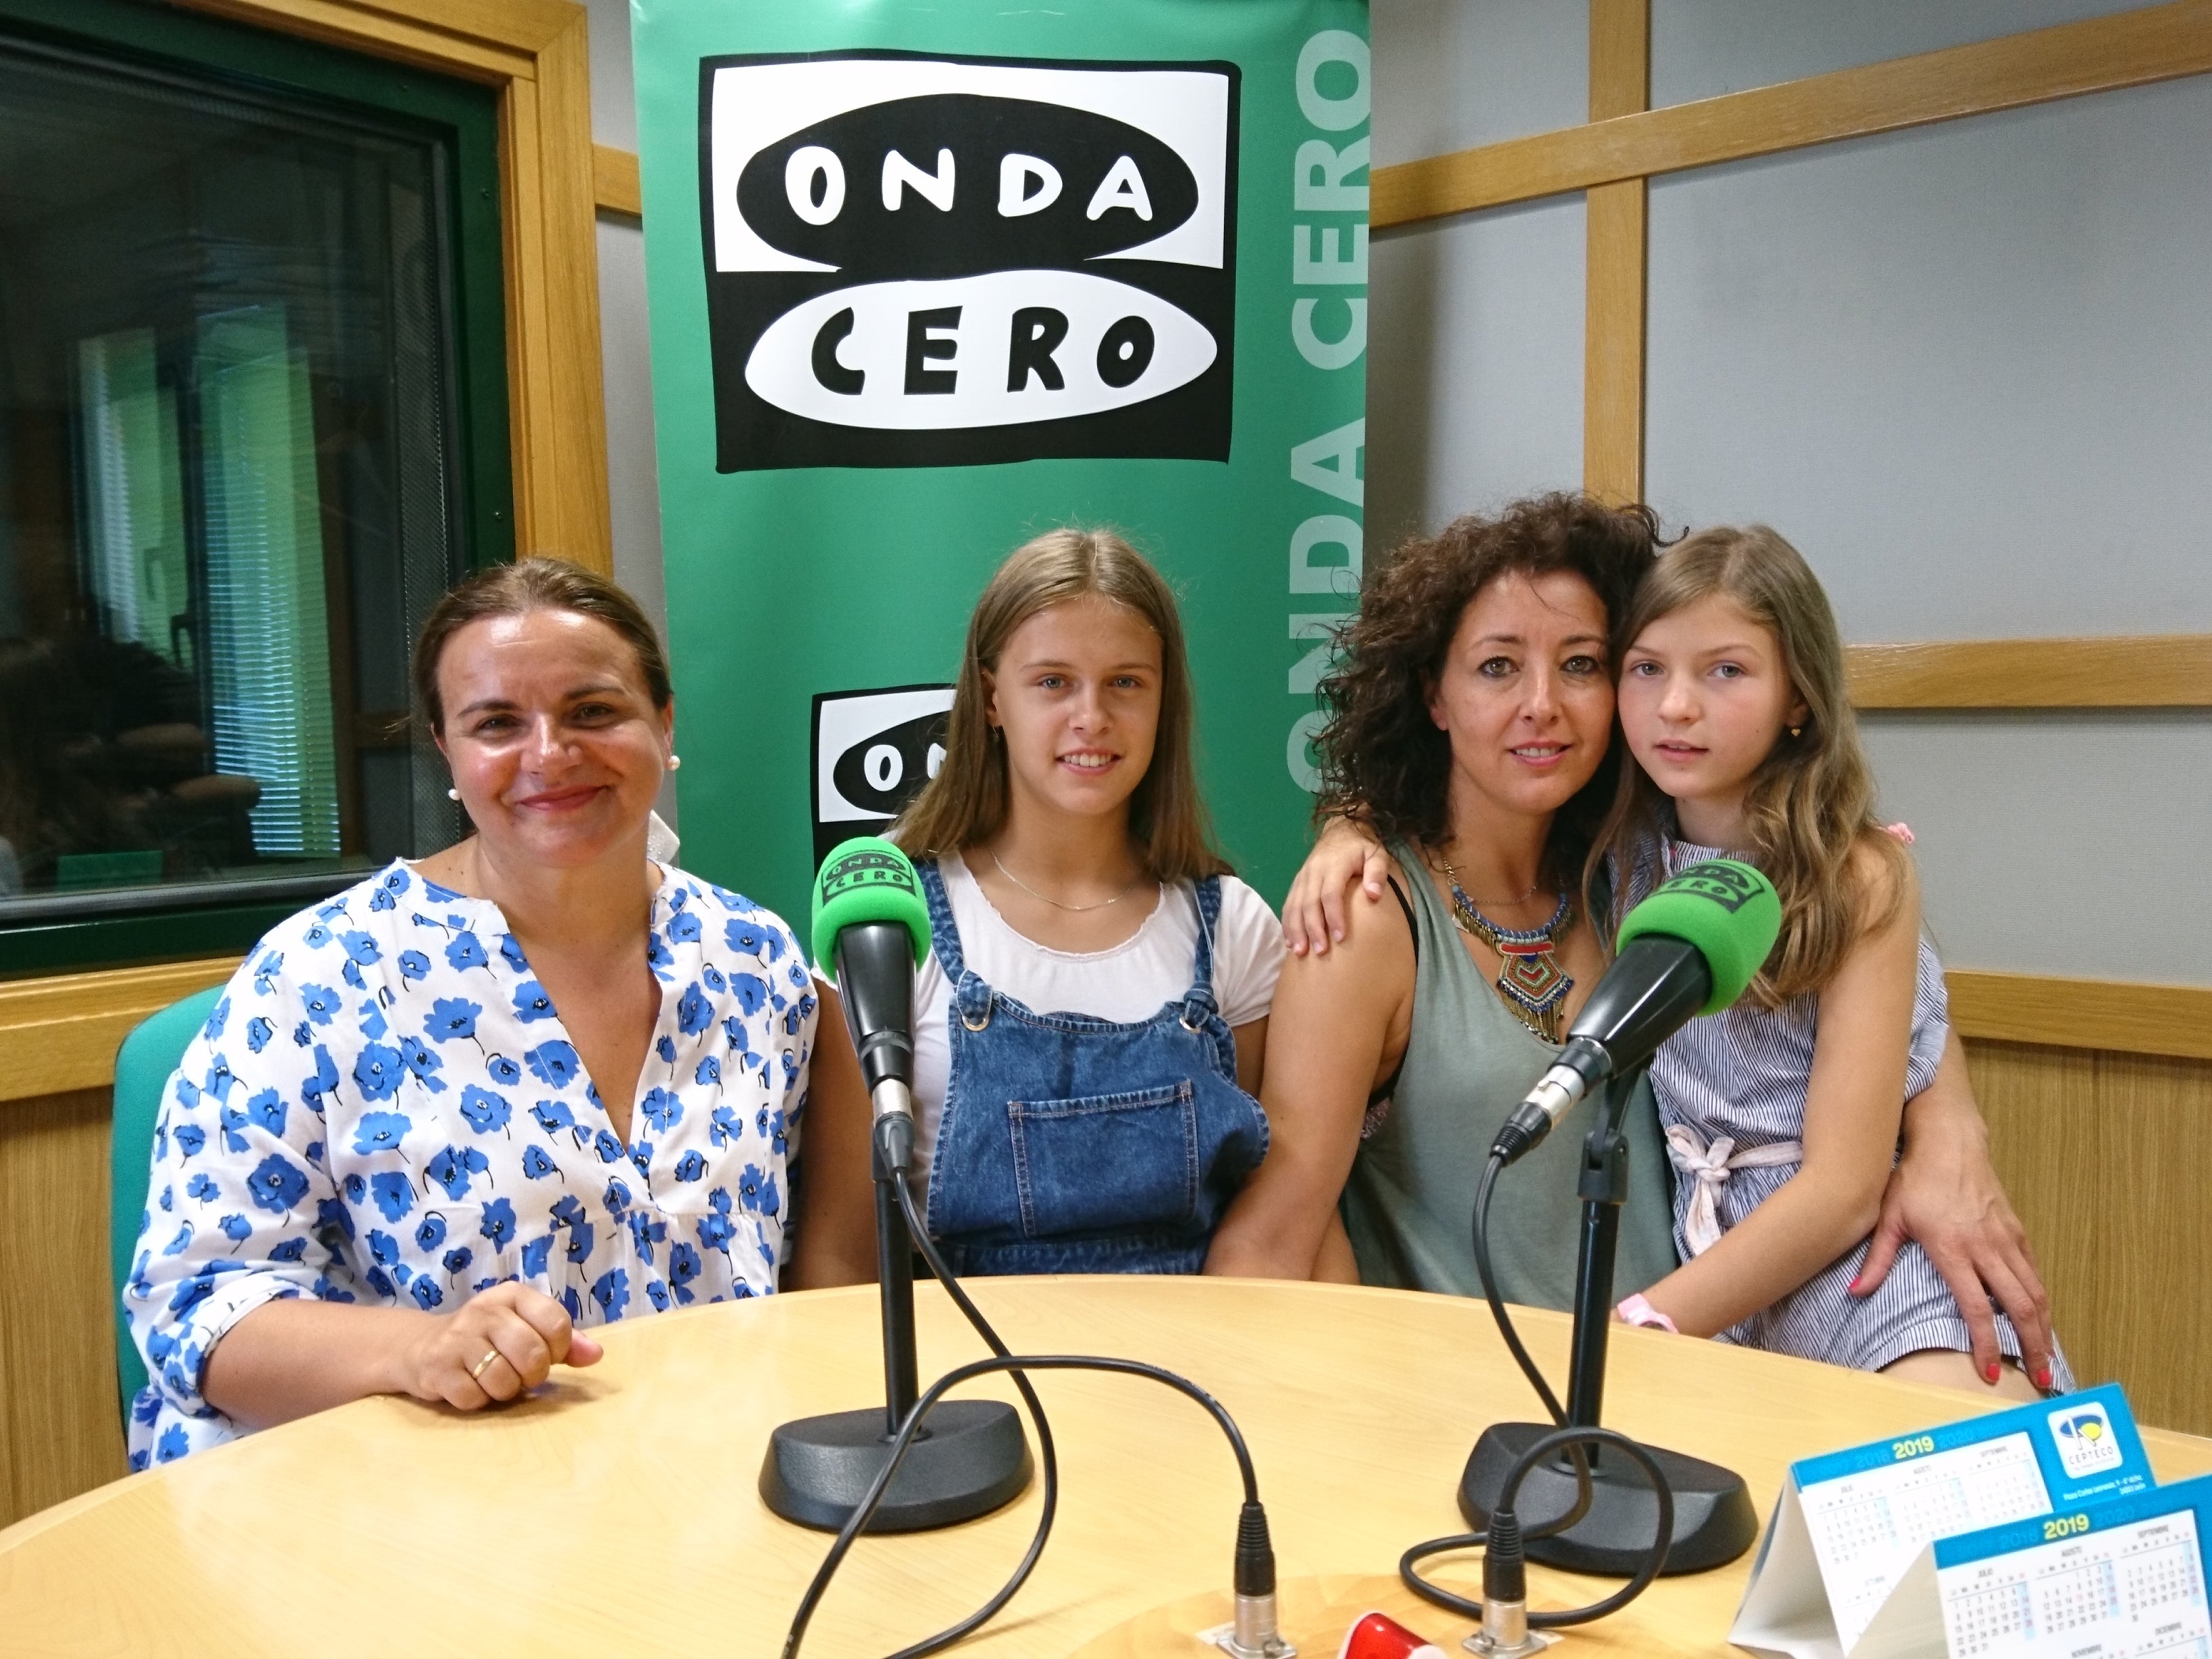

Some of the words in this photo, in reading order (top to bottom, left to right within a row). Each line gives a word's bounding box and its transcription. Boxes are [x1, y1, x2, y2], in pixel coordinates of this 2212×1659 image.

[784, 145, 1153, 226] ONDA
[1292, 29, 1371, 370] CERO
[811, 305, 1155, 396] CERO
[832, 857, 899, 876] ONDA
[836, 871, 903, 887] CERO
[1892, 1435, 1935, 1460] 2019
[2068, 1446, 2114, 1465] CEPTECO
[2043, 1513, 2090, 1540] 2019
